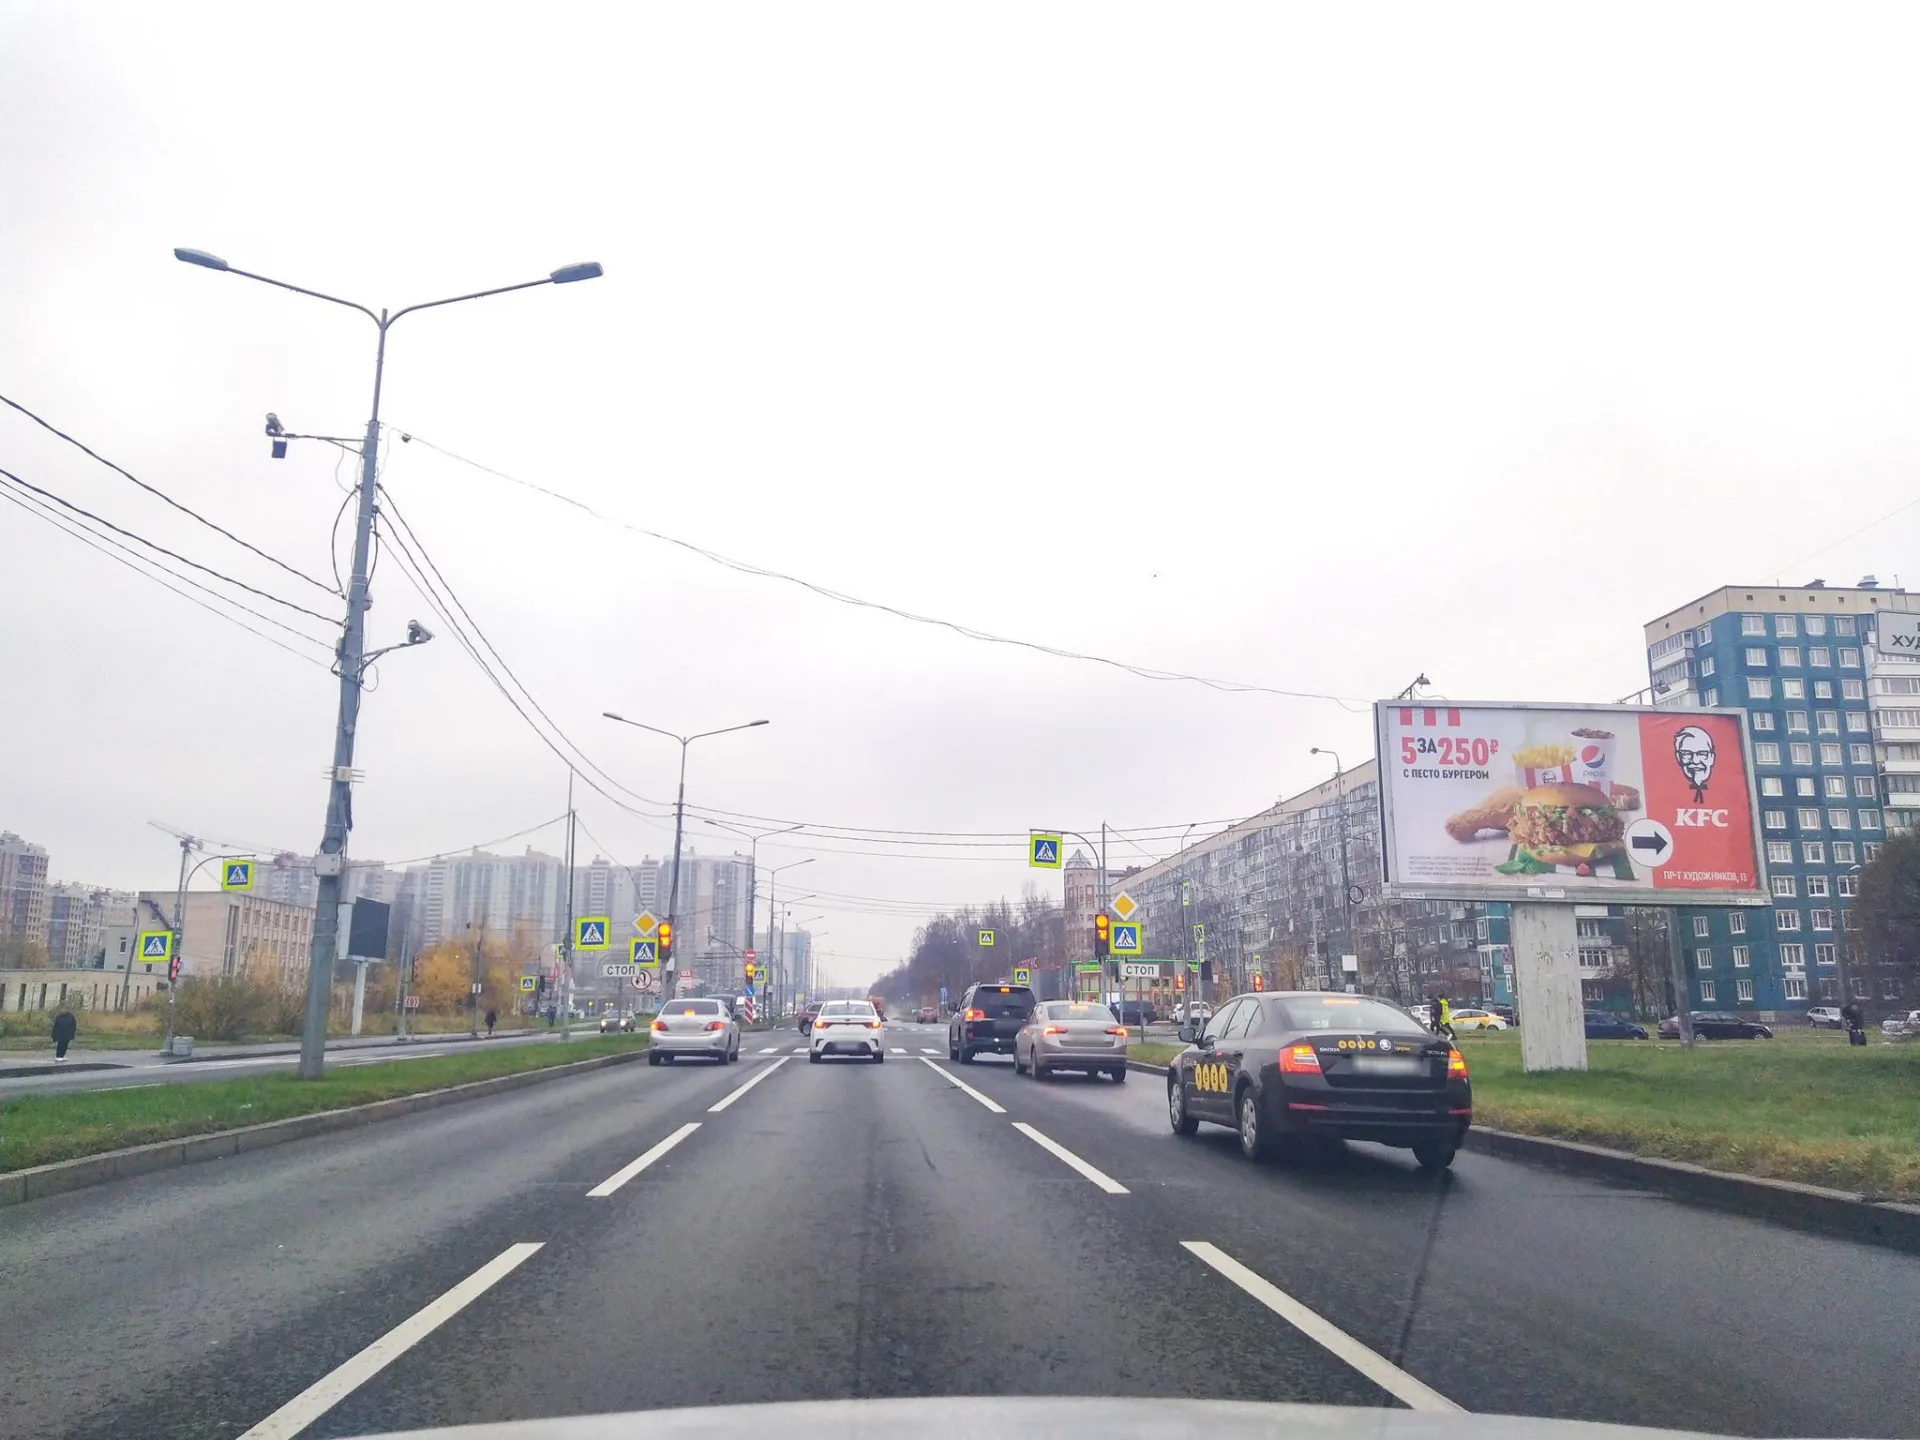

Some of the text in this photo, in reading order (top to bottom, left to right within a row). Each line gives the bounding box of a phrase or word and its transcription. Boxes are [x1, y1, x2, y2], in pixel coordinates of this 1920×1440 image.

[1403, 768, 1489, 780] С ПЕСТО БУРГЕРОМ
[1674, 808, 1729, 827] KFC
[1663, 870, 1682, 881] ПР-Т
[1739, 872, 1748, 882] 13
[607, 966, 636, 976] СТОП
[1126, 965, 1155, 976] СТОП
